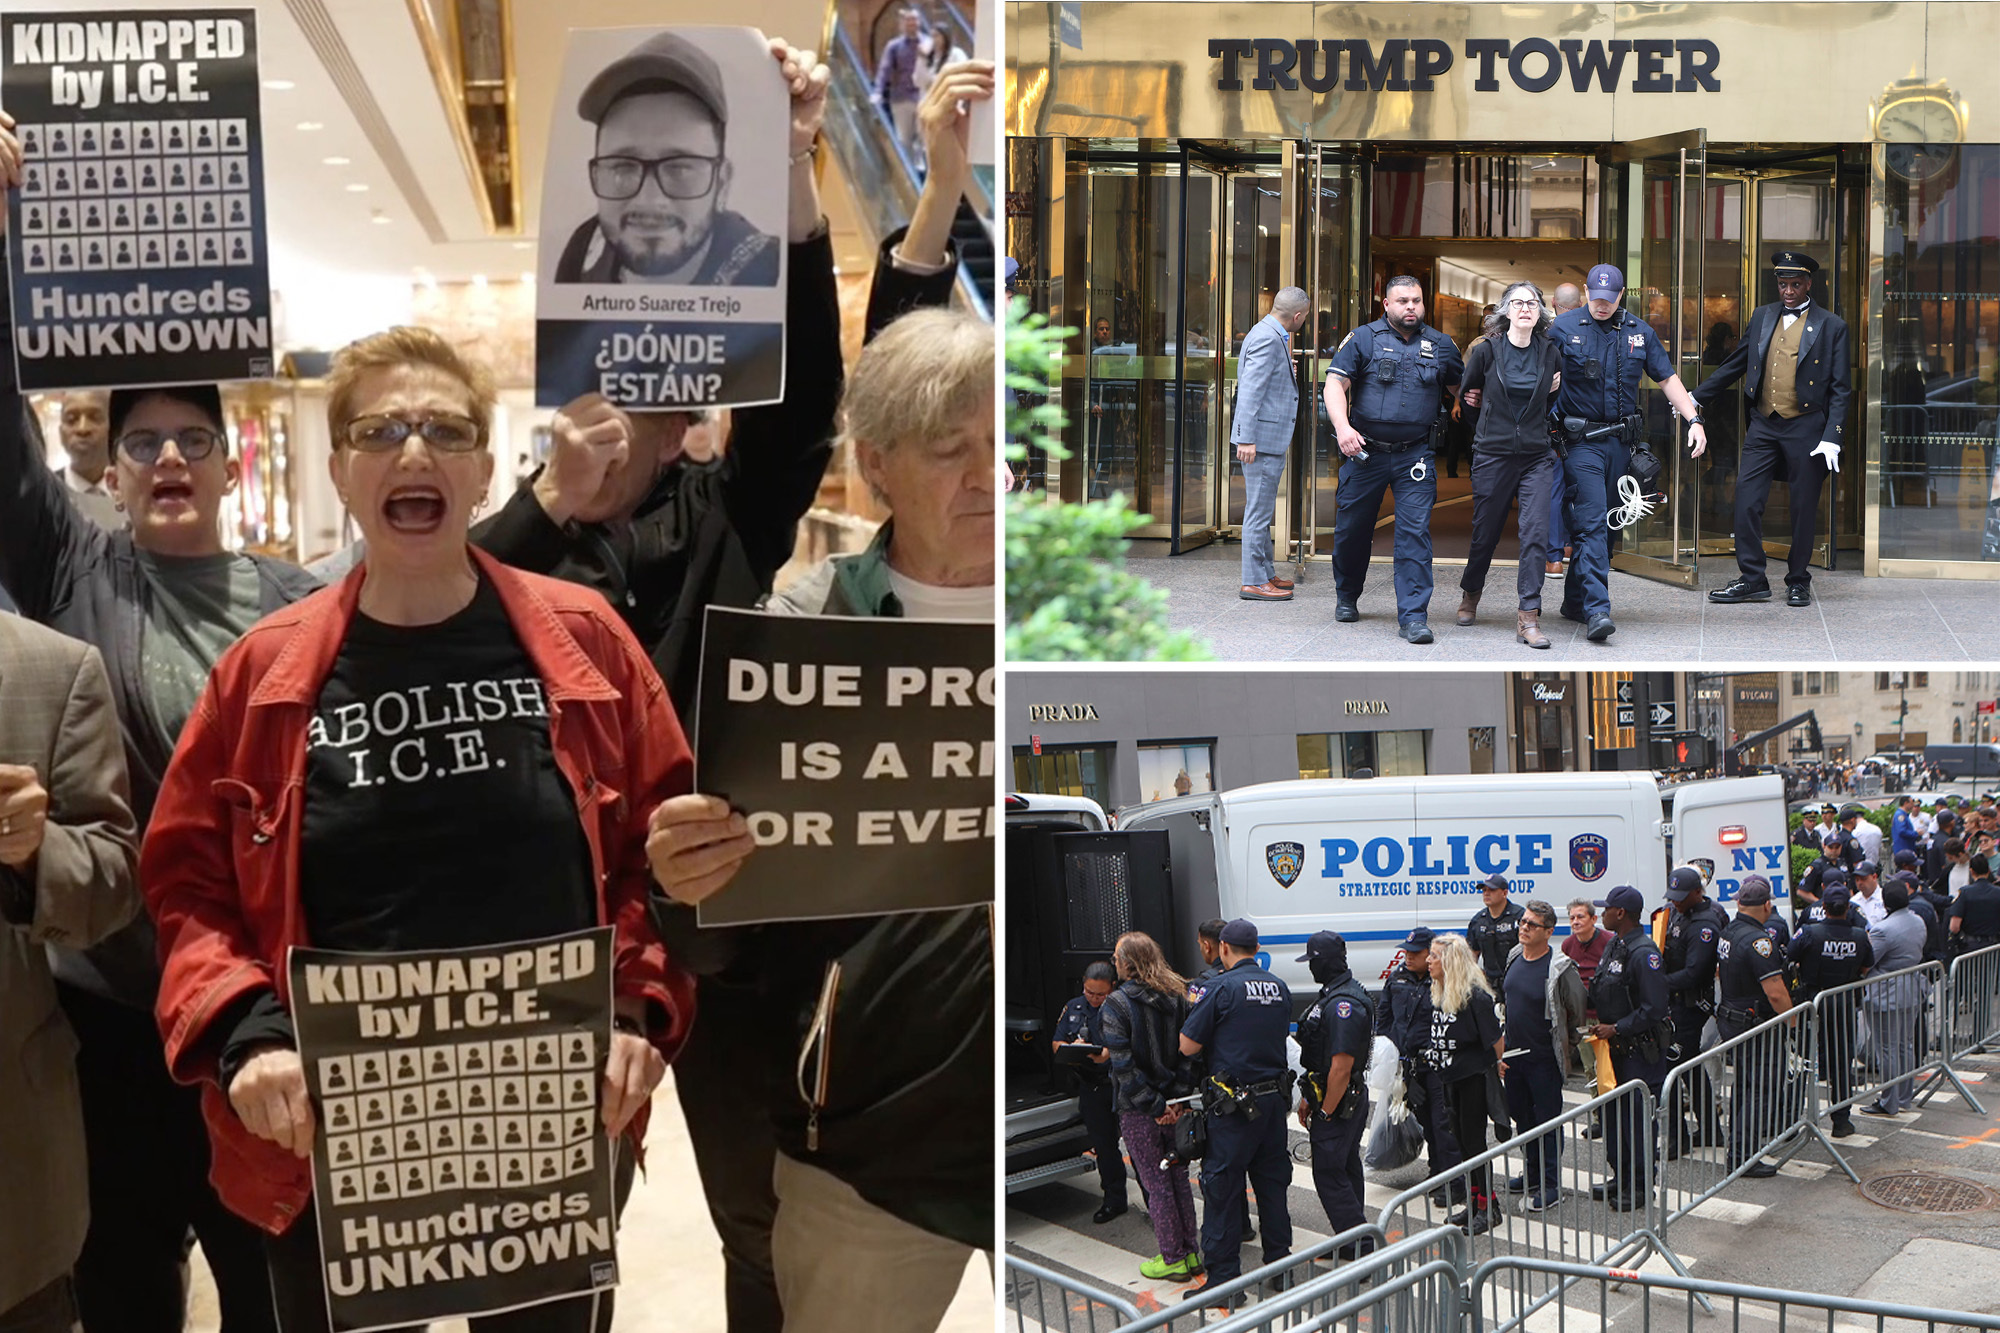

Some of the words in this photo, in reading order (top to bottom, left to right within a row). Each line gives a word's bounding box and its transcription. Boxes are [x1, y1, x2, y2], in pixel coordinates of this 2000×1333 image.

[12, 19, 245, 65] KIDNAPPED
[1208, 38, 1453, 92] TRUMP
[1465, 37, 1721, 92] TOWER
[51, 64, 103, 109] by
[112, 62, 210, 104] I.C.E.
[31, 281, 251, 319] Hundreds
[583, 295, 635, 312] Arturo
[639, 296, 695, 312] Suarez
[700, 297, 741, 315] Trejo
[18, 317, 269, 358] UNKNOWN
[595, 323, 726, 369] ¿DÓNDE
[600, 364, 722, 403] ESTÁN?
[727, 658, 862, 707] DUE
[306, 678, 549, 751] ABOLISH
[1029, 703, 1100, 722] PRADA
[1344, 700, 1390, 715] PRADA
[347, 729, 507, 788] I.C.E.
[781, 742, 842, 780] IS
[863, 742, 908, 779] A
[932, 741, 995, 778] RI
[746, 811, 833, 846] OR
[1573, 835, 1604, 848] POLICE
[1320, 833, 1552, 878] POLICE
[1731, 845, 1785, 871] NY
[1339, 880, 1411, 897] STRATEGIC
[1508, 879, 1534, 894] OUP
[1716, 874, 1788, 902] PL
[1823, 940, 1857, 953] NYPD
[305, 938, 596, 1004] KIDNAPPED
[1244, 981, 1280, 996] NYPD
[358, 1005, 421, 1039] by
[434, 989, 550, 1031] I.C.E.
[1431, 1024, 1450, 1038] SAY
[342, 1192, 591, 1254] Hundreds
[328, 1216, 612, 1296] UNKNOWN
